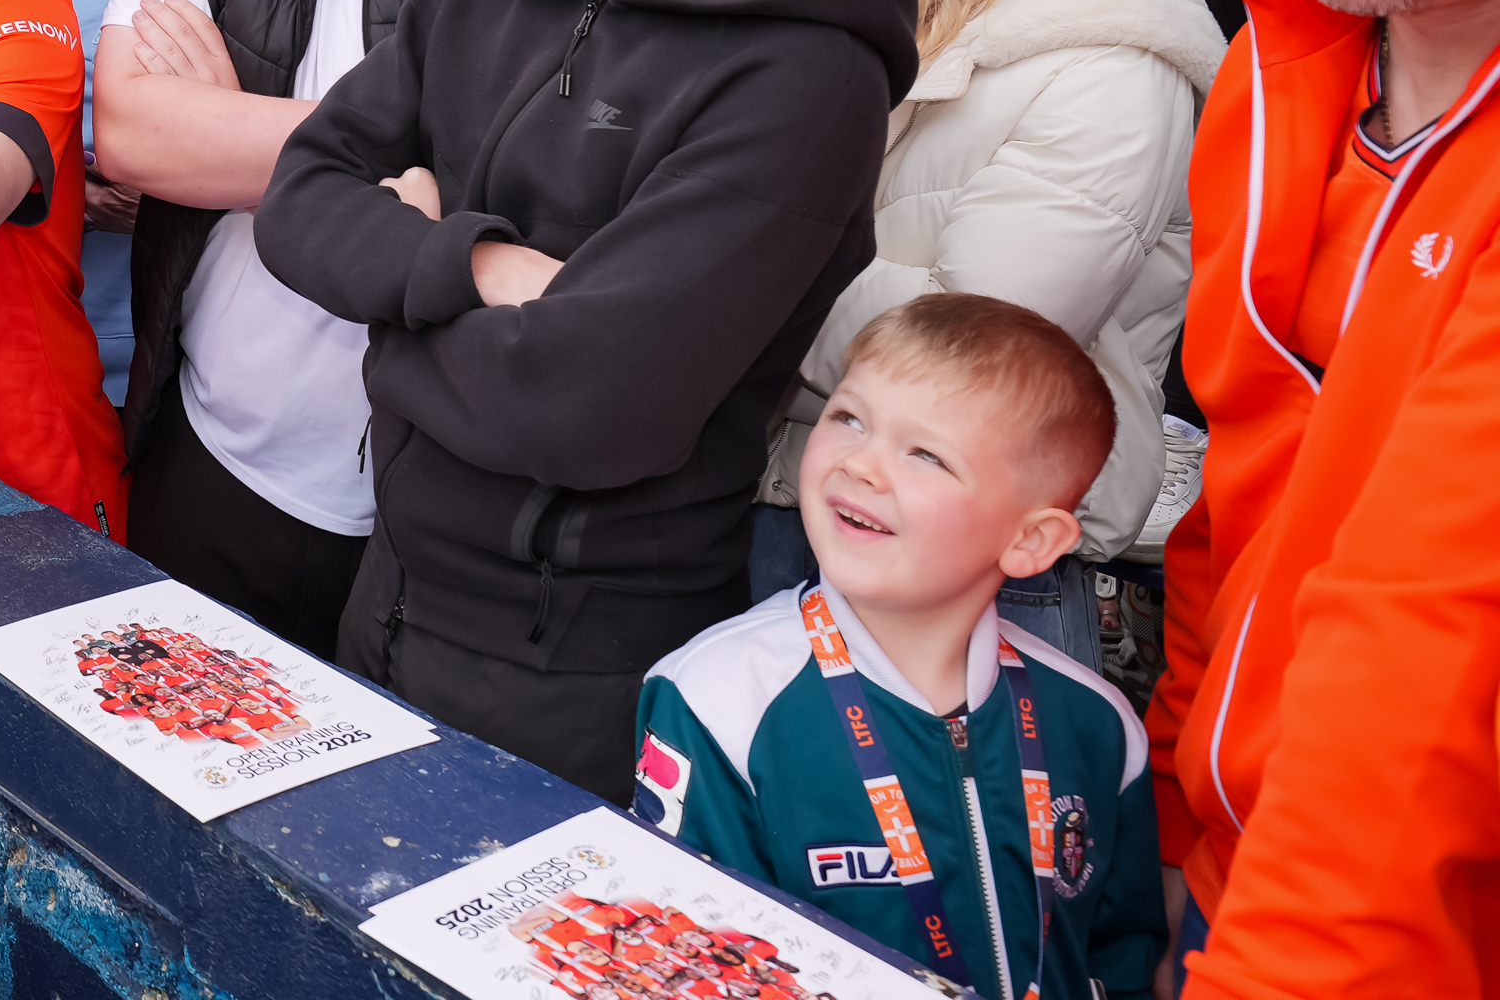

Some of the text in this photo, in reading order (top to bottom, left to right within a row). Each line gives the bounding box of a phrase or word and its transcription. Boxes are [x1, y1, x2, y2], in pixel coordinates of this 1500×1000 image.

[845, 704, 875, 748] LTFC
[1019, 697, 1037, 739] LTFC
[226, 720, 355, 769] OPEN TRAINING
[236, 745, 321, 780] SESSION
[318, 729, 373, 752] 2025
[487, 856, 572, 903] SESSION
[435, 897, 493, 930] 2025
[458, 869, 588, 940] OPEN TRAINING
[925, 915, 954, 959] LTFC
